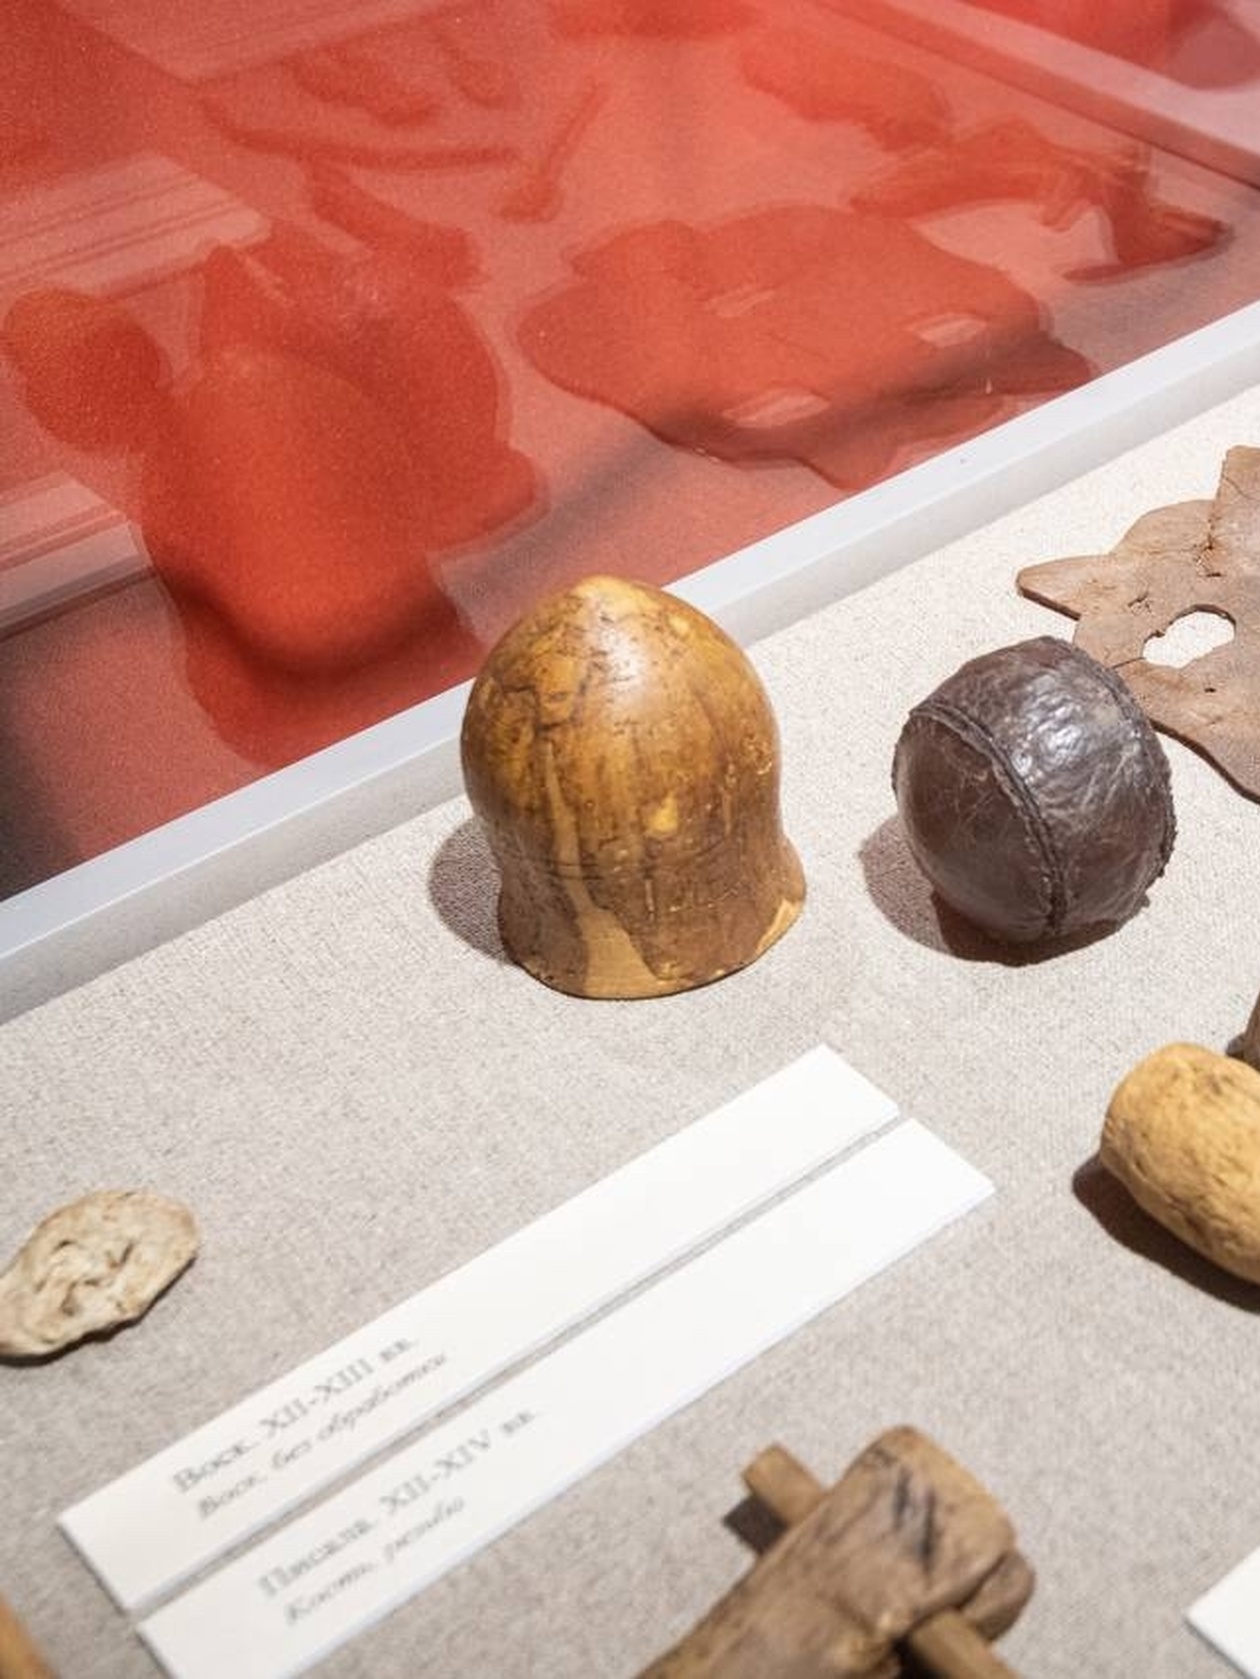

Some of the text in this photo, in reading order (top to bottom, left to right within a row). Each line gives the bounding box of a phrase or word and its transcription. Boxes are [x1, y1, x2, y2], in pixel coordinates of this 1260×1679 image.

[171, 1439, 261, 1495] Воск.
[256, 1356, 376, 1441] XII-XIII
[196, 1351, 449, 1522] Воск, без обработки
[377, 1426, 493, 1518] XII-XIV
